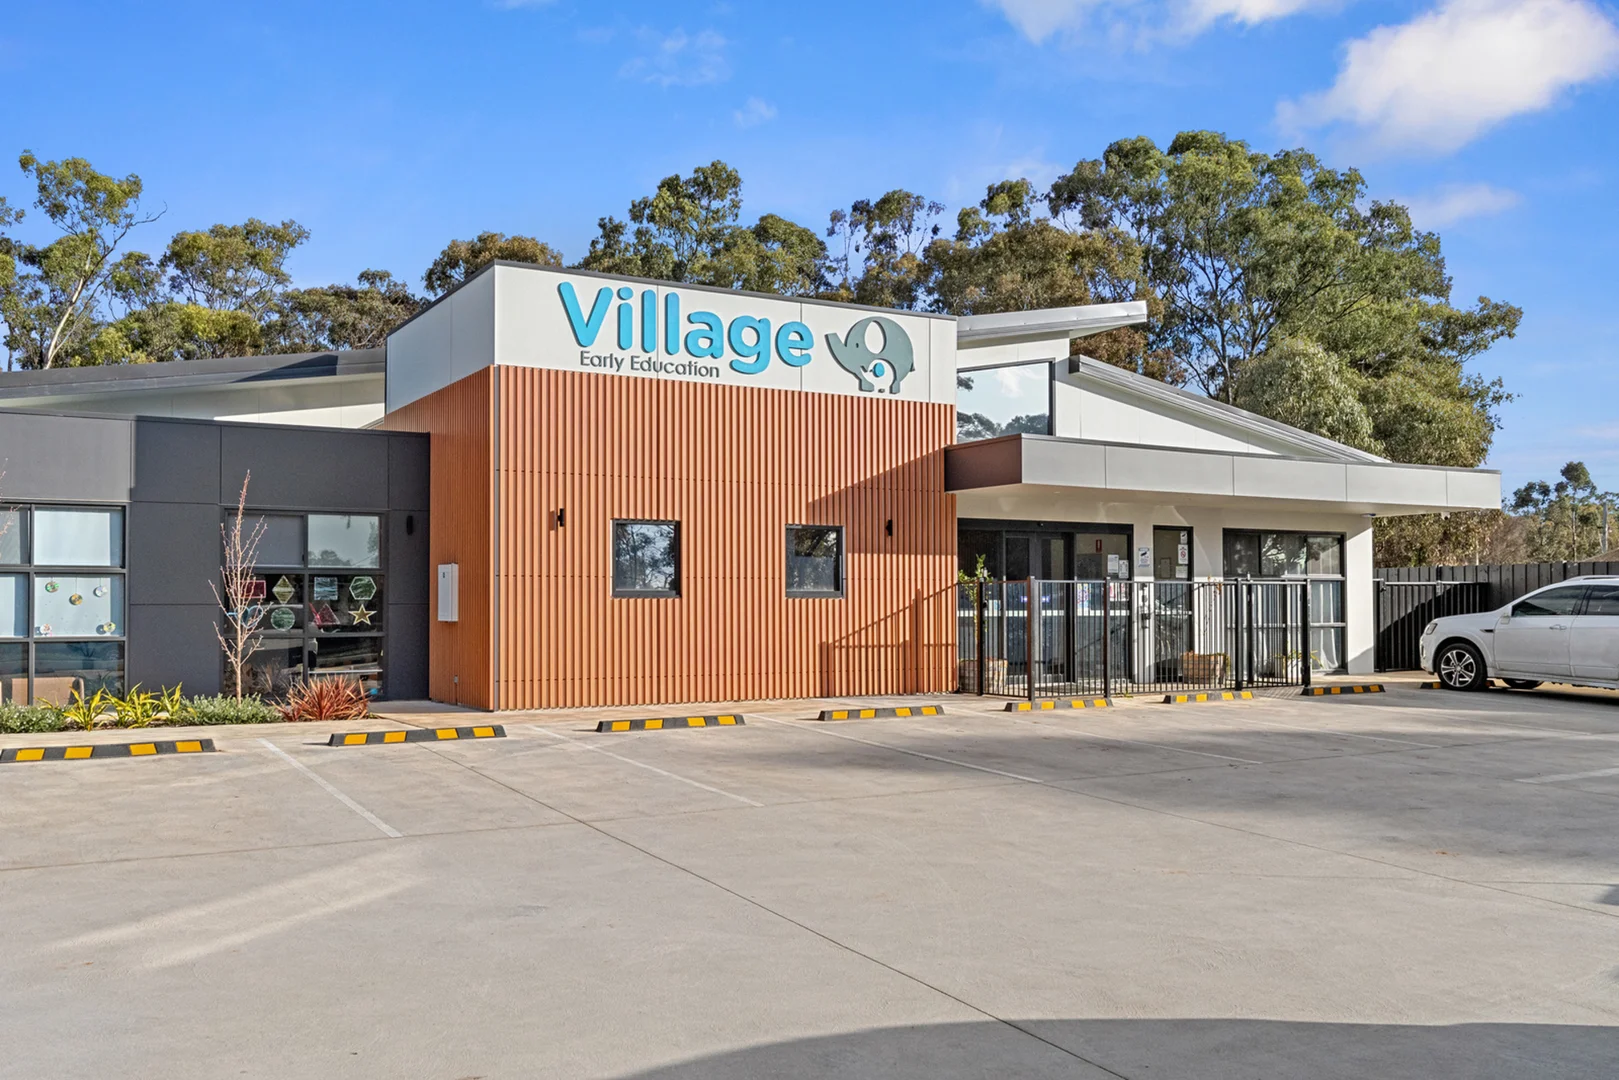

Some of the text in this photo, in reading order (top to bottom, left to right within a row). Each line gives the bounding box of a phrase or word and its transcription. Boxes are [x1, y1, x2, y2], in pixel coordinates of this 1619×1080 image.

[557, 281, 815, 375] Village
[580, 350, 720, 378] Early Education
